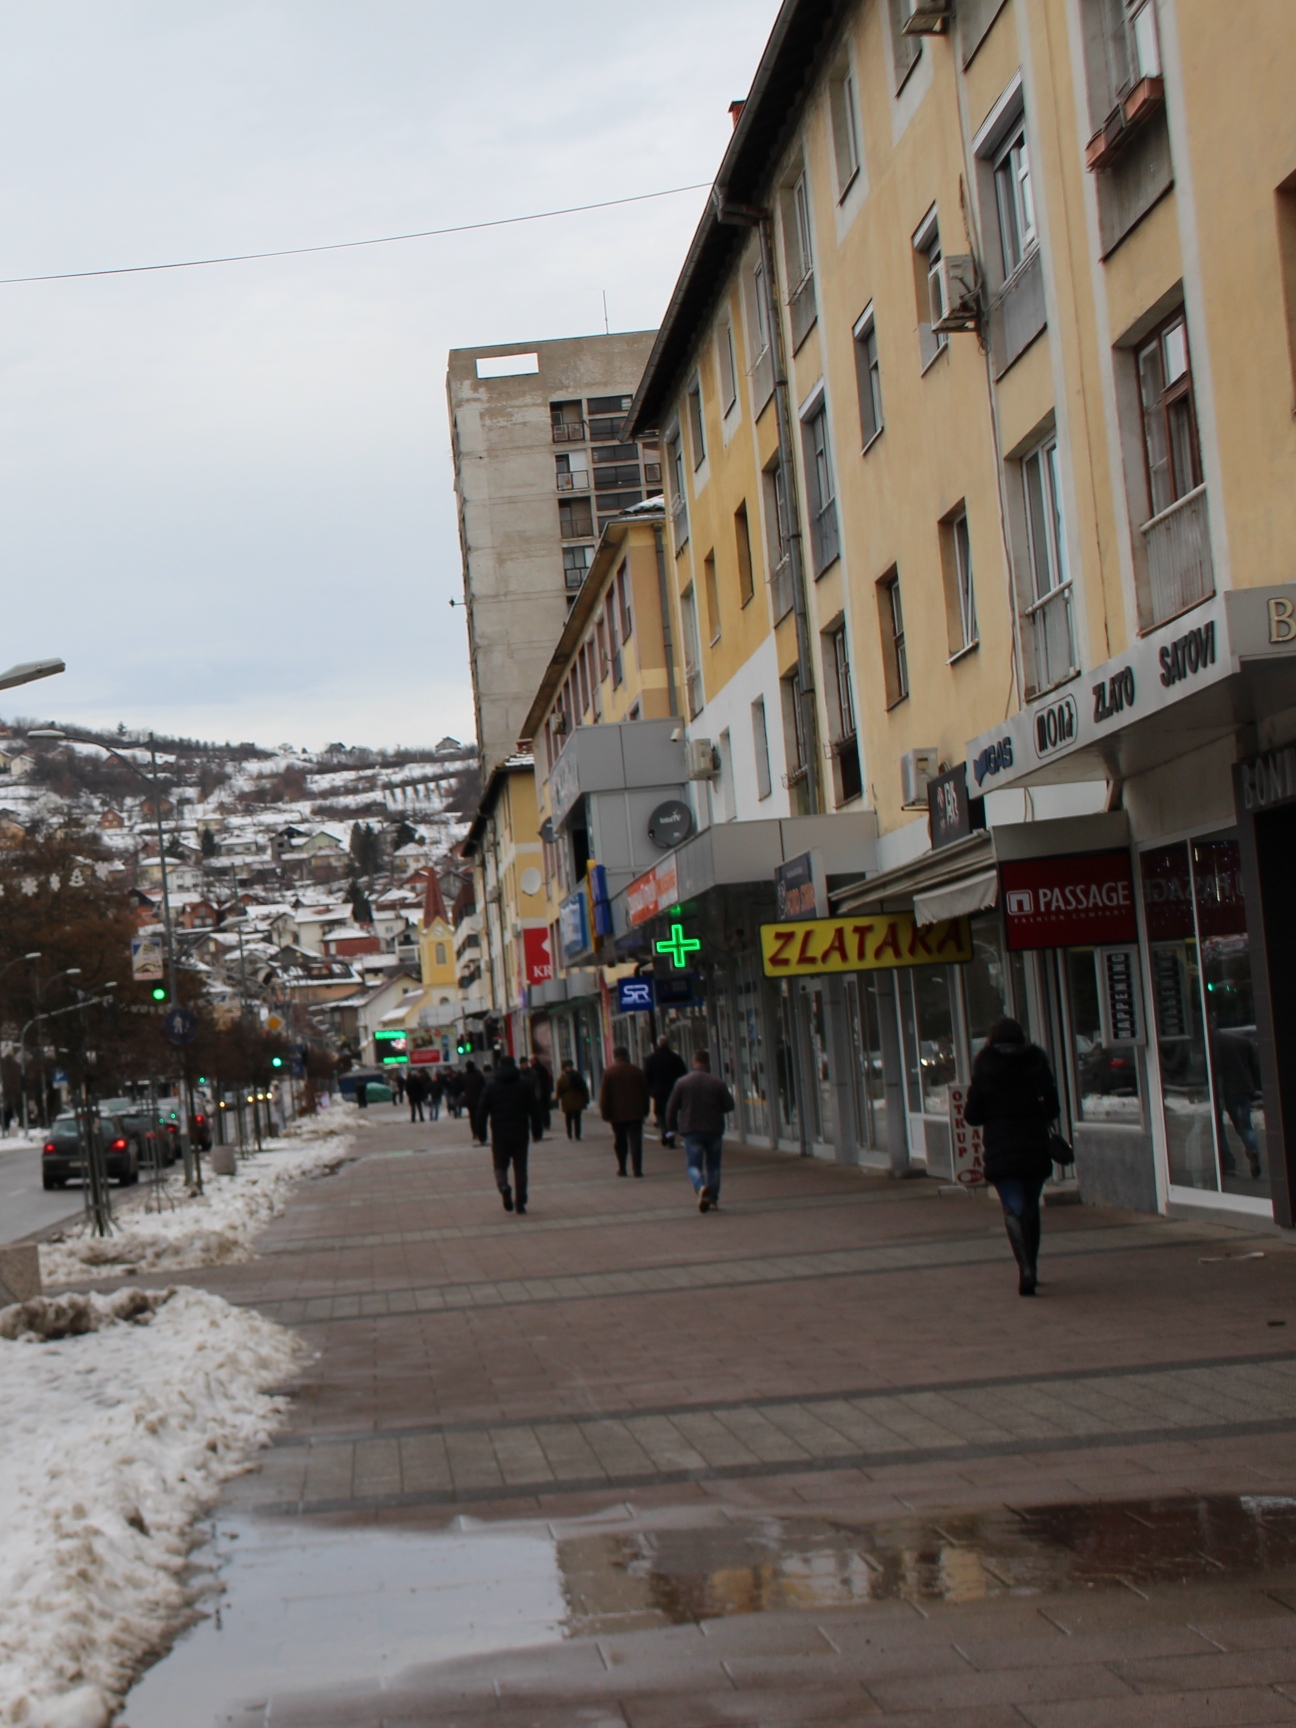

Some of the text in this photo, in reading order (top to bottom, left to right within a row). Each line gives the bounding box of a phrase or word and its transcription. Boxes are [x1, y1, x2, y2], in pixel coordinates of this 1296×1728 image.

[1092, 665, 1135, 723] ZLATO
[1159, 620, 1216, 688] SATOVI
[1015, 909, 1127, 924] FASHION COMPANY
[1039, 881, 1130, 912] PASSAGE
[1111, 954, 1132, 1039] HAPPENING
[952, 1090, 967, 1158] OTKUP
